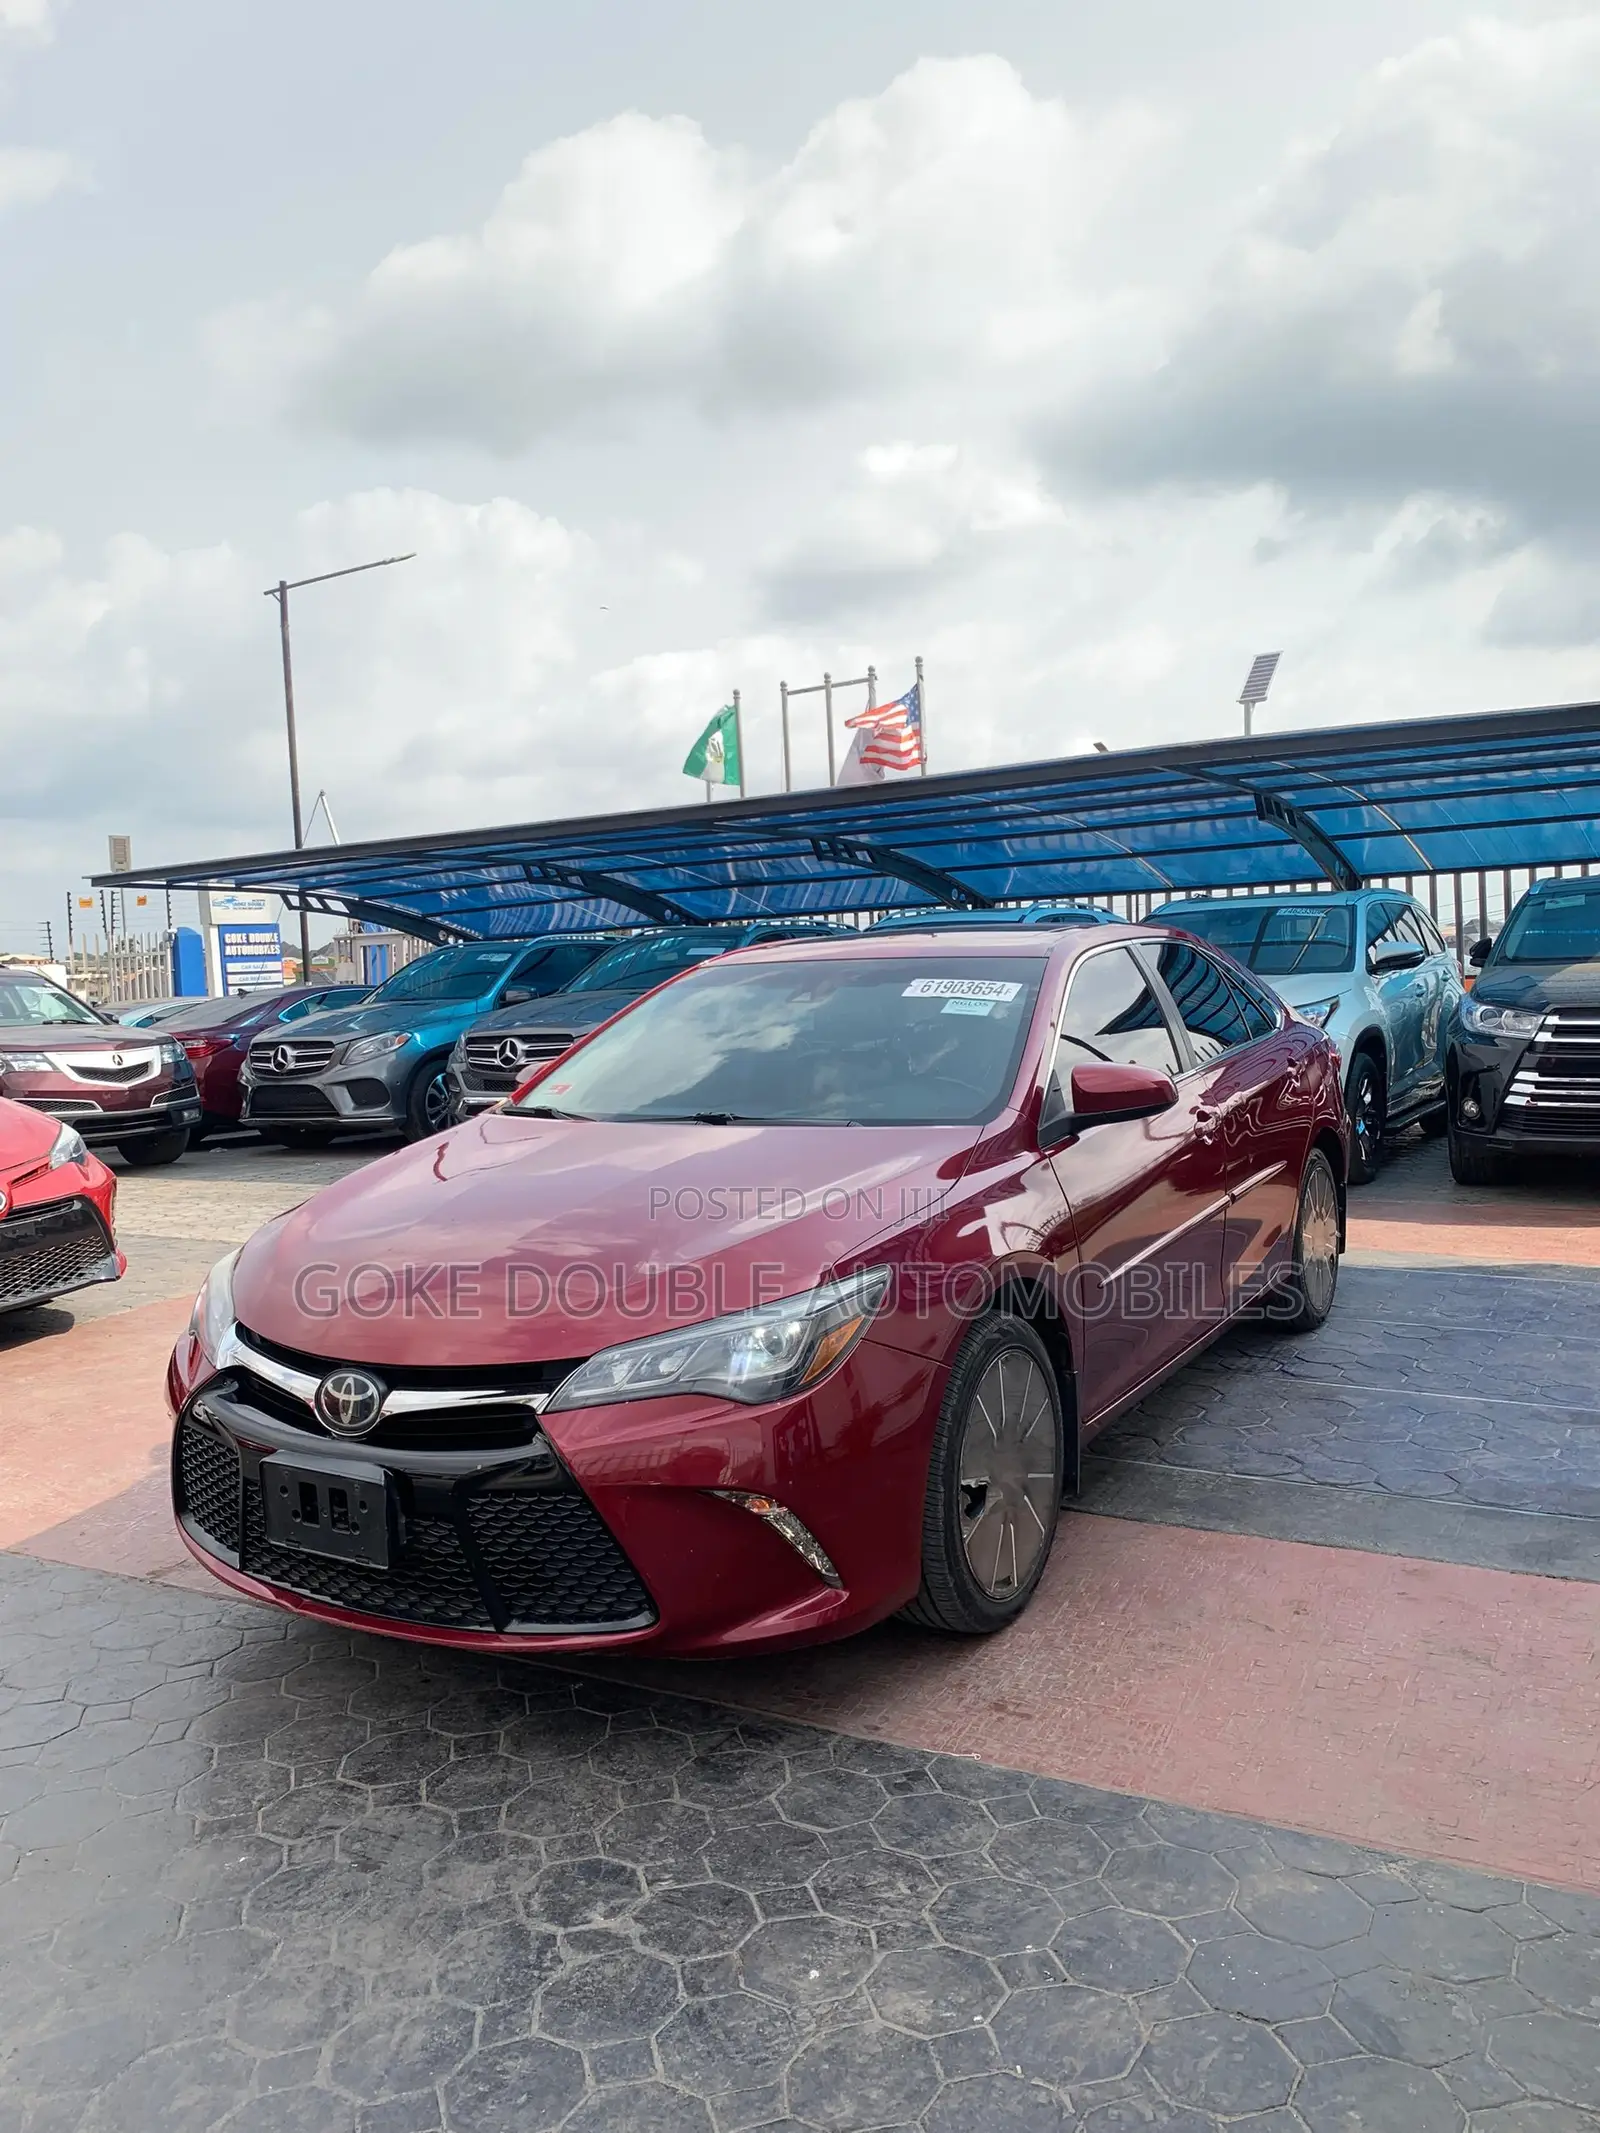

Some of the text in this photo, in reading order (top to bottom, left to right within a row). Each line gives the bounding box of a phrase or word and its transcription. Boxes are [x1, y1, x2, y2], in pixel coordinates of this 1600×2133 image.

[249, 933, 278, 943] DOUBLE
[225, 945, 281, 955] AUTOMOBILES
[920, 980, 1006, 995] 61903654
